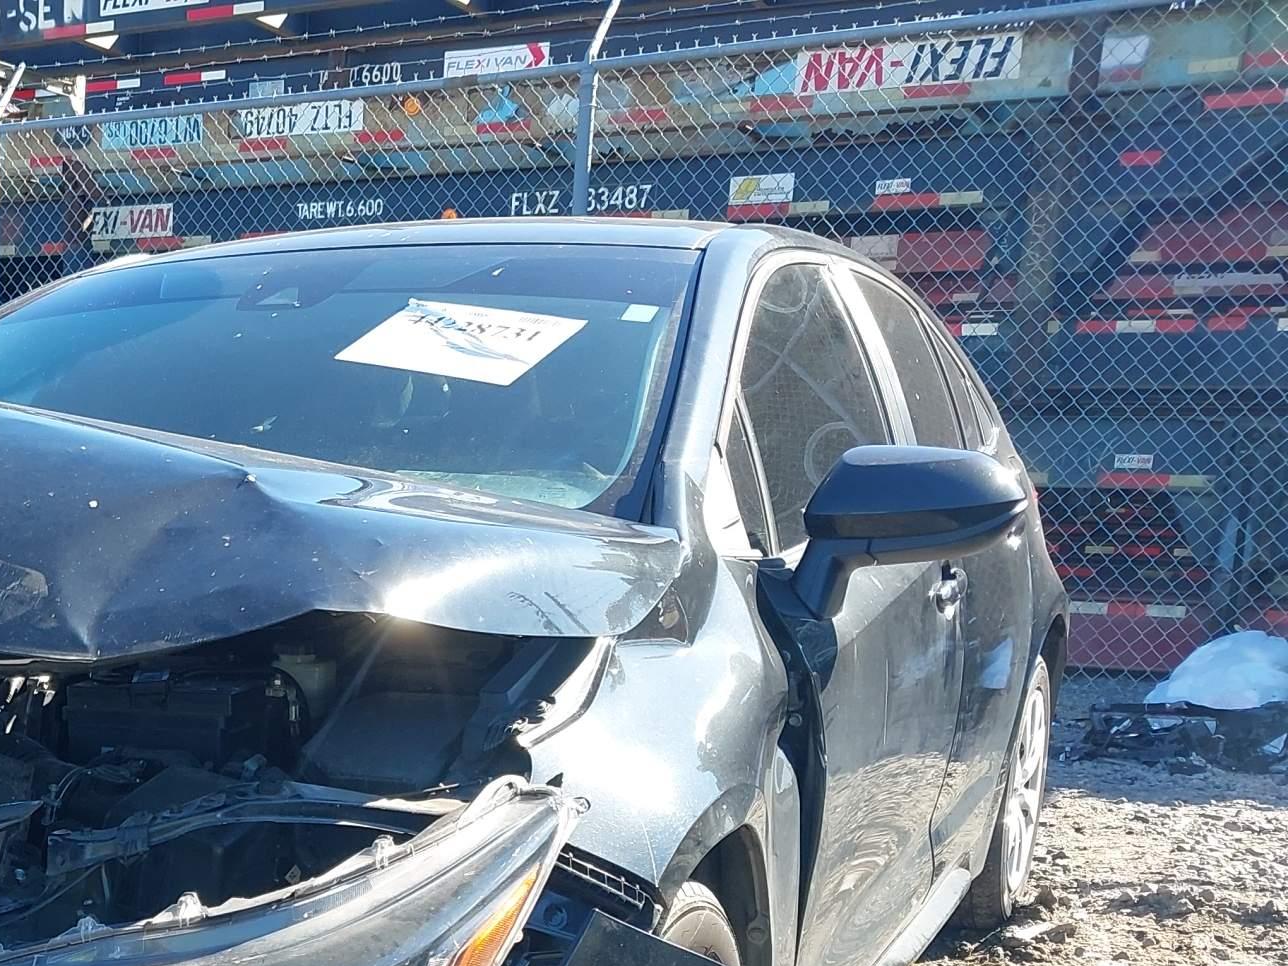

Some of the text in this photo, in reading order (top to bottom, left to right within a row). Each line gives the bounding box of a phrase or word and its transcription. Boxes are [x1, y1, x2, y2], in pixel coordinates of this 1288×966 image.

[447, 54, 528, 72] FLEXI VAN
[800, 35, 1016, 93] FLEXI-VAN
[309, 103, 353, 132] FLTZ
[511, 184, 653, 216] FLXZ 33487
